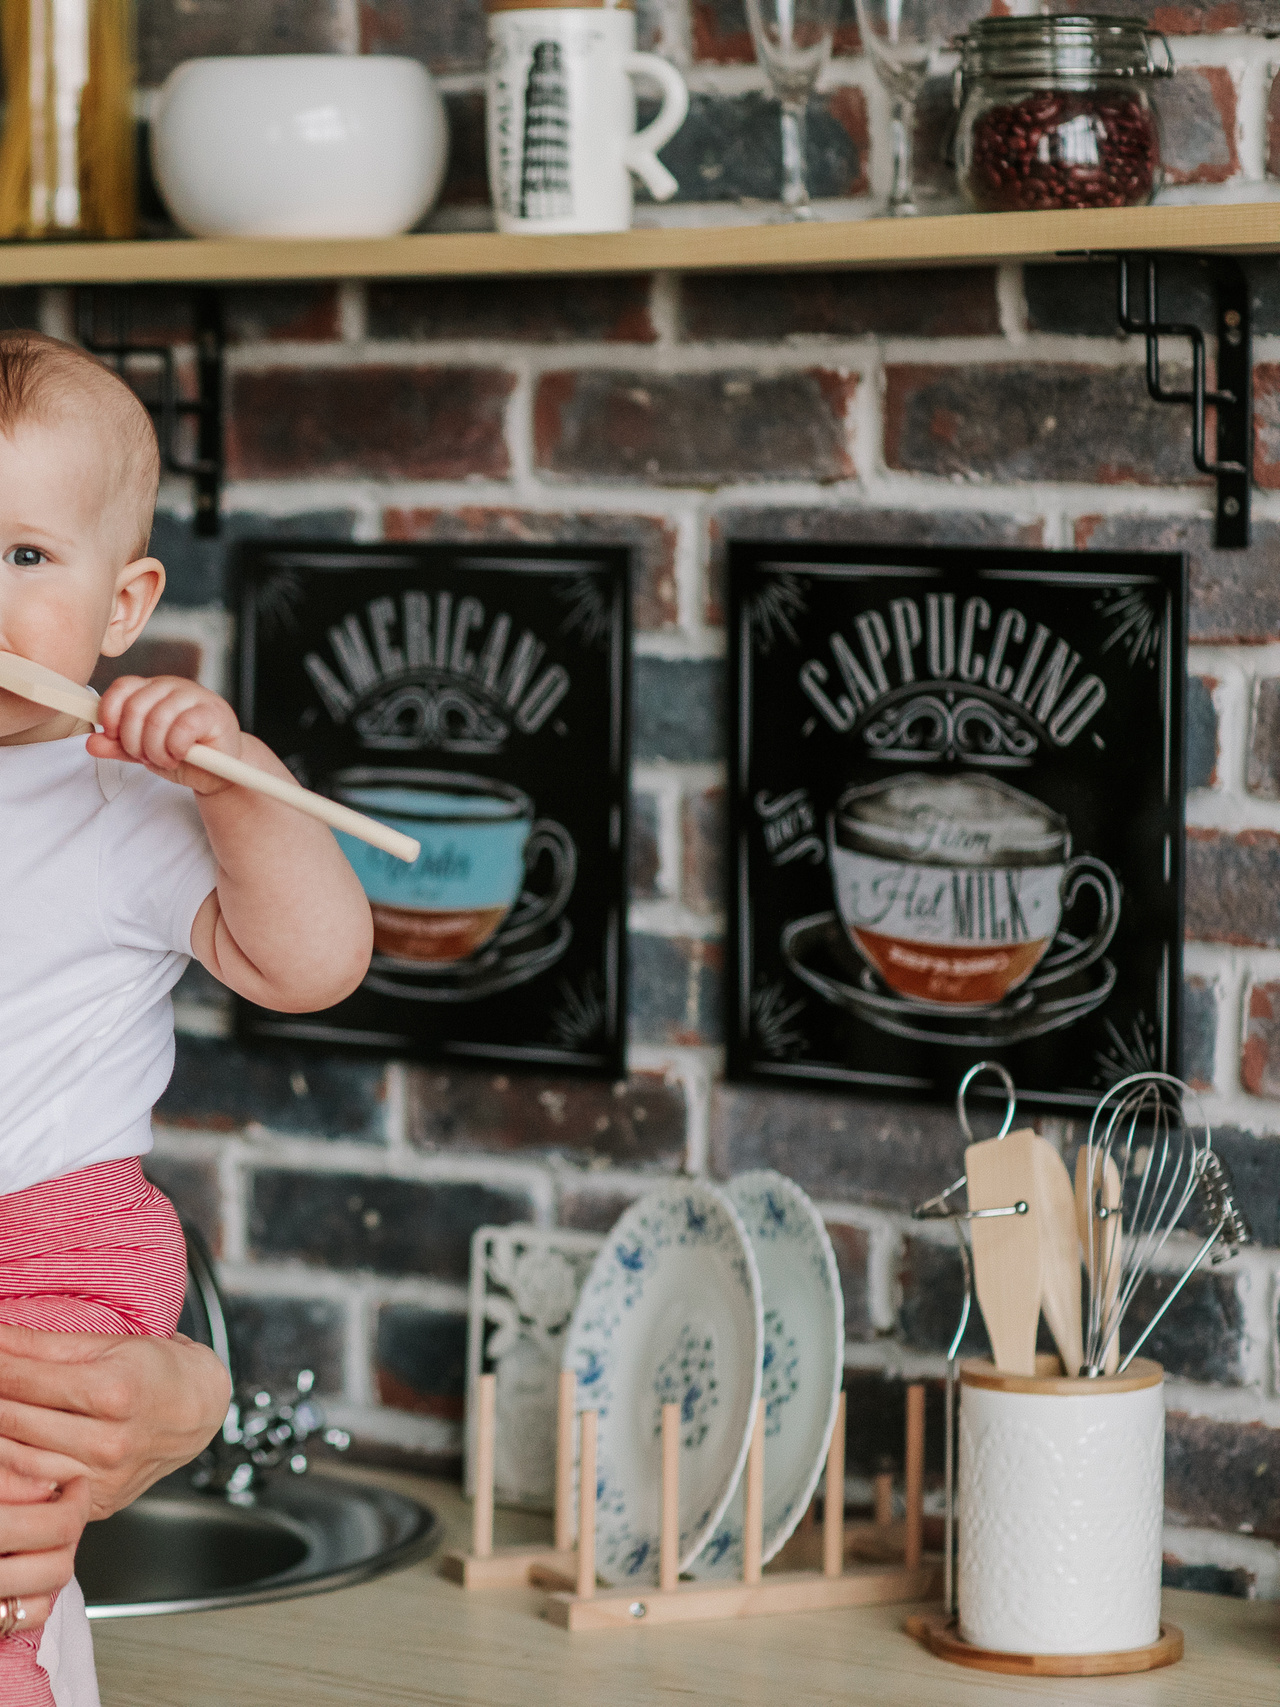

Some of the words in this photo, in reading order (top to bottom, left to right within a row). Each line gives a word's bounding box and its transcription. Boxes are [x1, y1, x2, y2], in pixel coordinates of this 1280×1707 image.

[303, 590, 570, 734] AMERICANO
[799, 593, 1107, 746] CAPPUCCINO
[952, 867, 1030, 940] MILK
